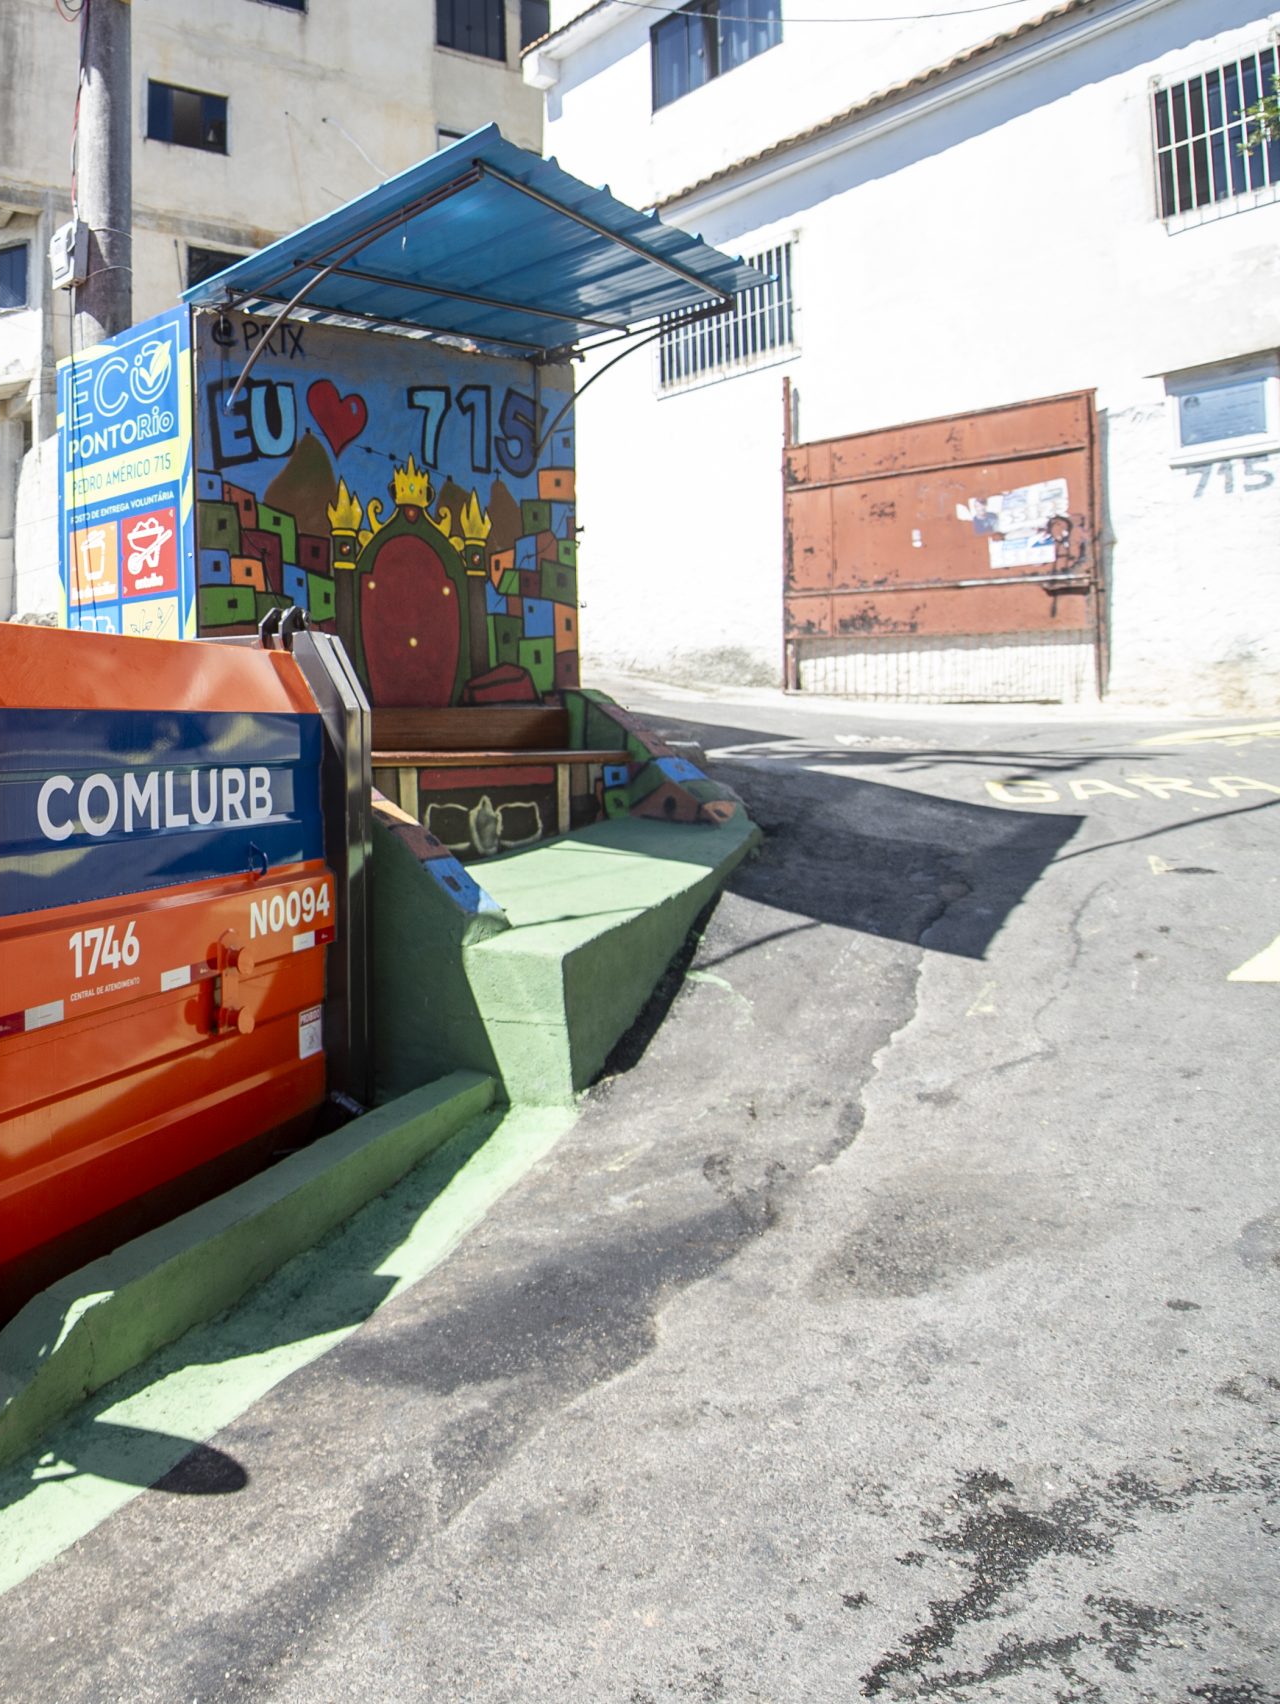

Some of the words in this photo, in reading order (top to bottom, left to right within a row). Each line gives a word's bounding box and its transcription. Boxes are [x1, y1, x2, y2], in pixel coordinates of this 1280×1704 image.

[68, 340, 172, 431] ECO
[206, 376, 298, 470] EU
[407, 384, 548, 478] 715
[73, 474, 102, 496] PEDRO
[106, 458, 150, 485] AMÉRICO
[154, 453, 171, 472] 715
[1186, 454, 1275, 498] 715
[91, 509, 101, 519] DE
[100, 502, 130, 516] ENTREGA
[130, 490, 174, 508] VOLUNTÁRIA
[37, 766, 273, 841] COMLURB
[68, 920, 140, 978] 1746
[70, 988, 95, 1002] CENTRAL
[96, 985, 105, 995] DE
[104, 976, 141, 992] ATENDIMENTO
